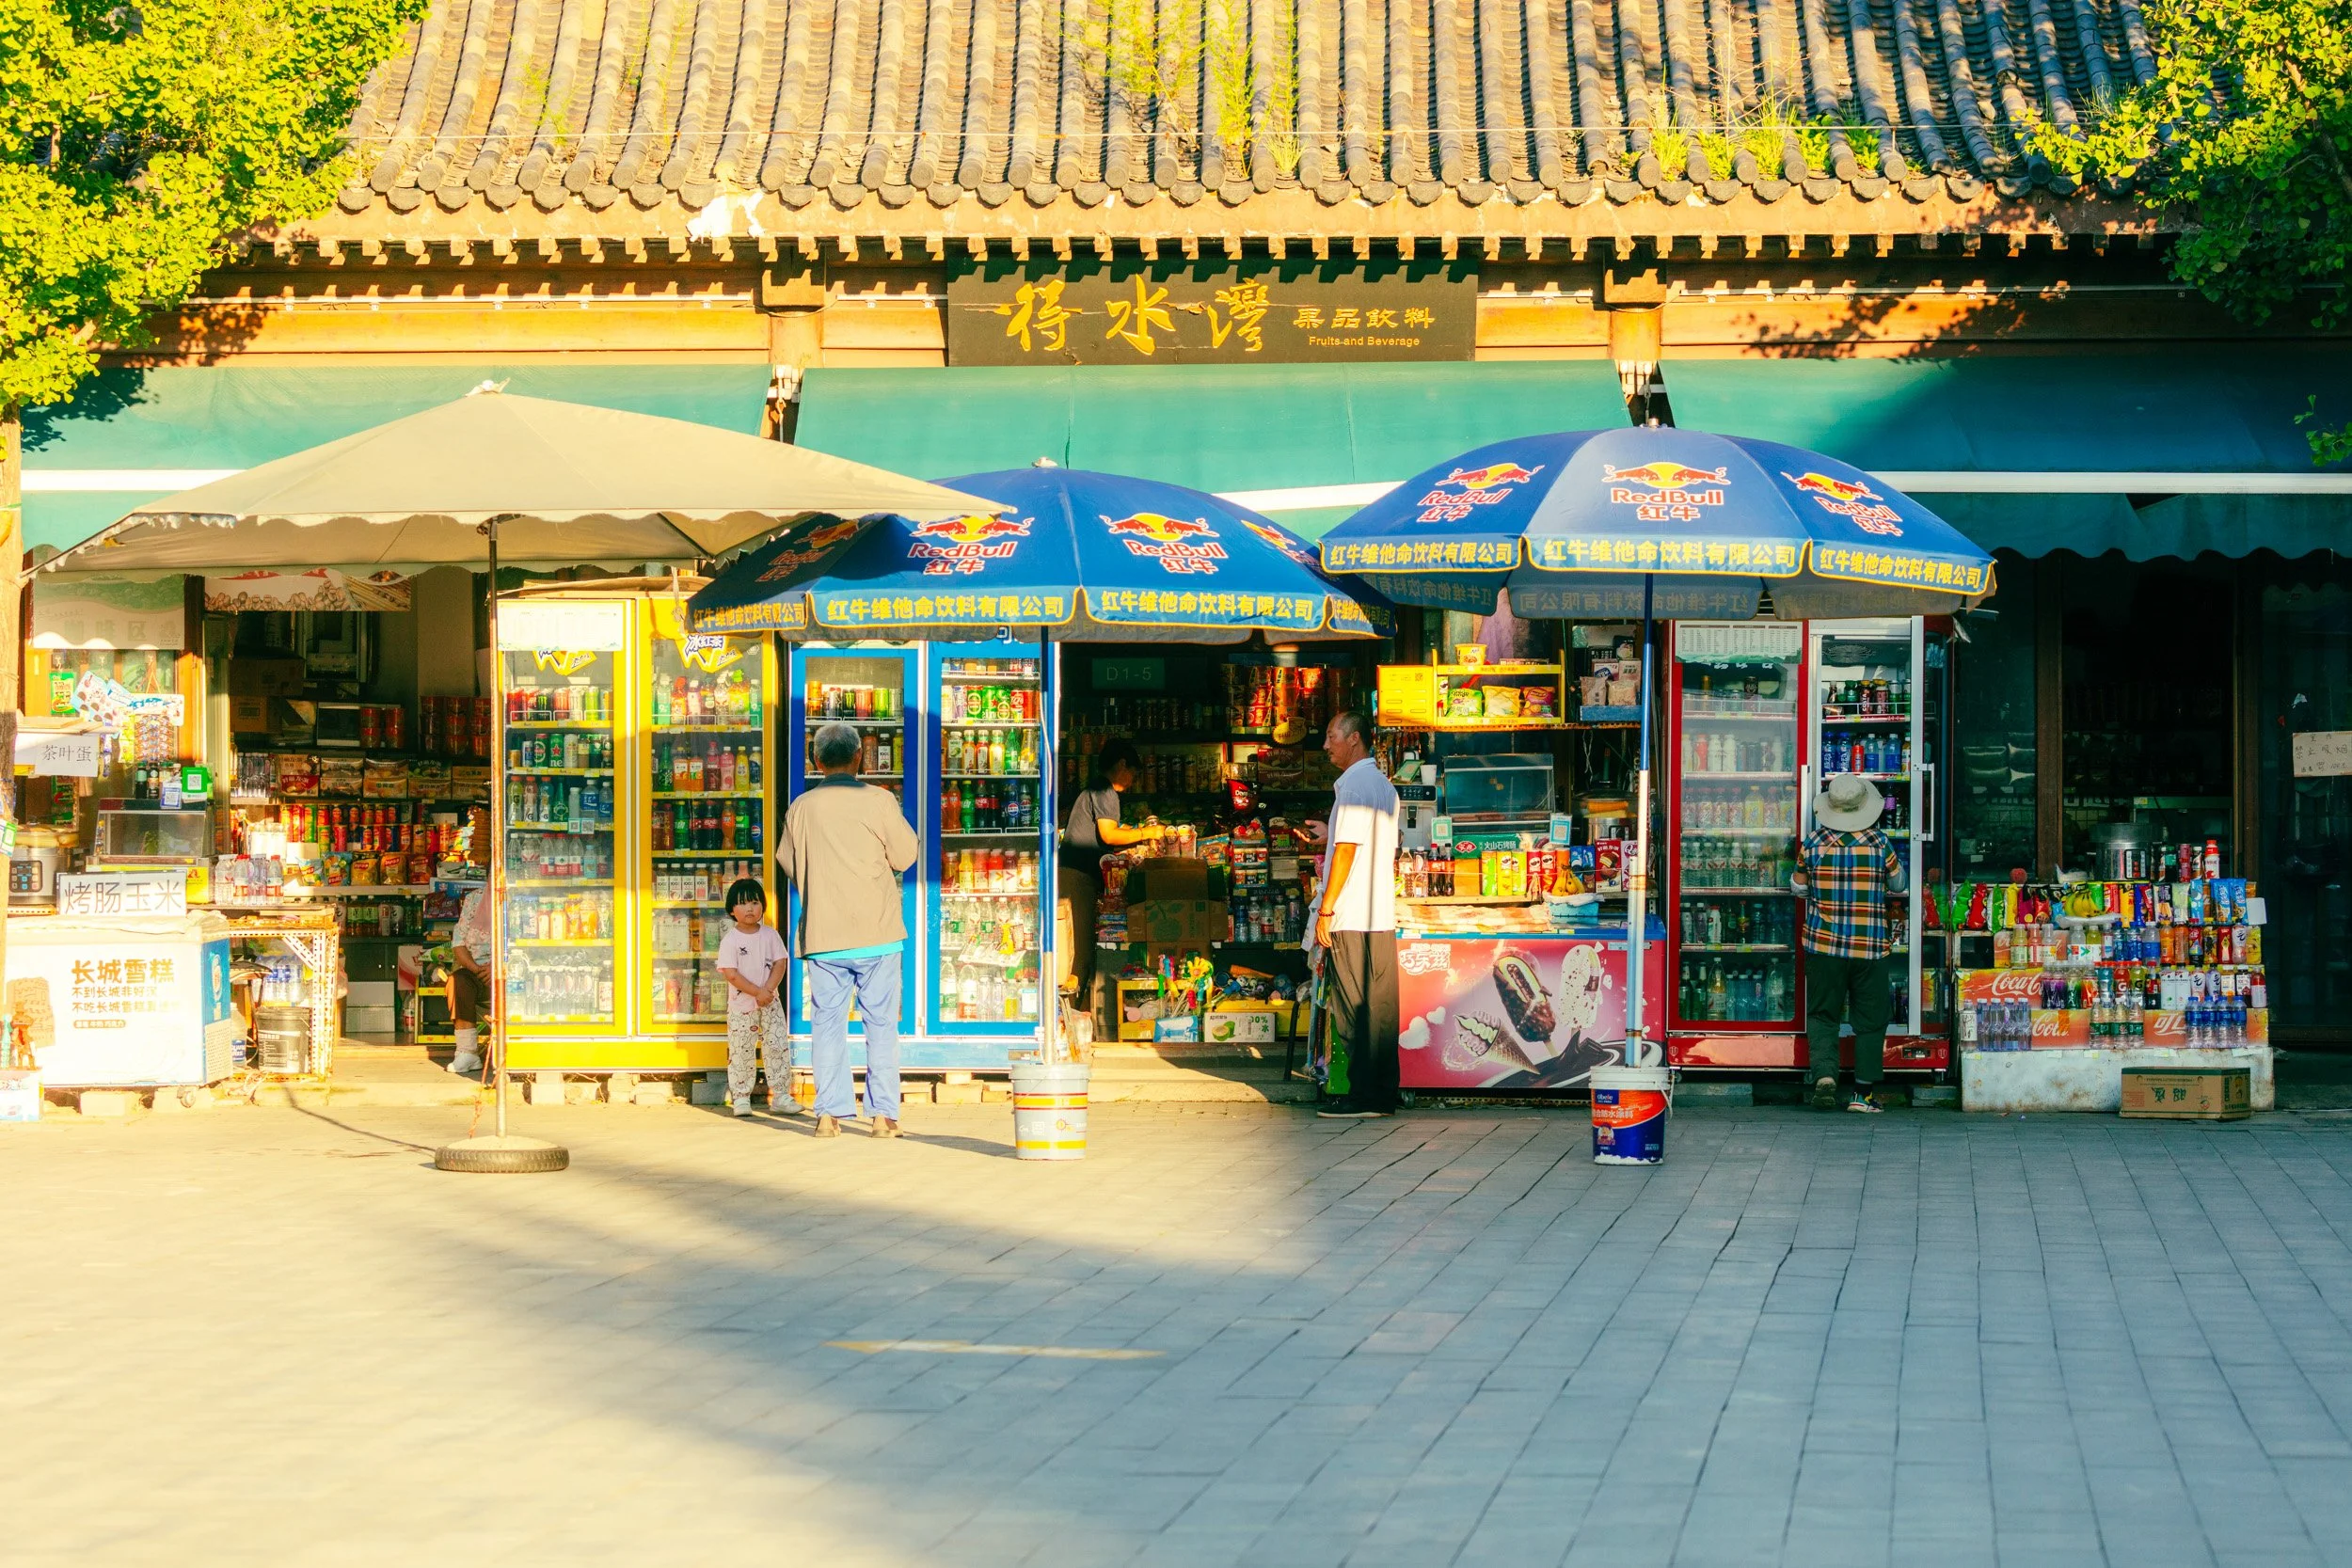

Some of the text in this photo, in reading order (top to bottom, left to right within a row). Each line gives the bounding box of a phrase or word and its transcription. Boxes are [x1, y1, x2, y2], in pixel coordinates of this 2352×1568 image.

[1294, 308, 1435, 329] 果品飲料
[1309, 336, 1420, 349] Fruits and Beverage
[1417, 488, 1513, 506] RedBull
[1611, 487, 1724, 506] RedBull
[1416, 505, 1473, 523] 红牛
[1637, 505, 1700, 521] 红牛
[1813, 496, 1903, 522] RedBull
[1852, 516, 1903, 536] 红牛
[908, 541, 1018, 559] RedBull
[1122, 539, 1230, 559] RedBull
[1330, 542, 1513, 566] 红牛维他命饮料有限公司
[1544, 540, 1796, 568] 红牛维他命饮料有限公司
[923, 559, 985, 575] 红牛
[1159, 557, 1219, 575] 红牛
[1820, 547, 1982, 590] 红牛维他命饮料有限公司
[693, 603, 804, 628] 红牛维他命饮料有限公司
[827, 594, 1064, 622] 红牛维他命饮料有限公司
[1101, 590, 1314, 621] 红牛维他命饮料有限公司
[1106, 667, 1152, 681] D1-5
[42, 745, 91, 762] 茶叶蛋
[64, 880, 182, 914] 烤肠玉米
[72, 958, 176, 984] 长城雪糕
